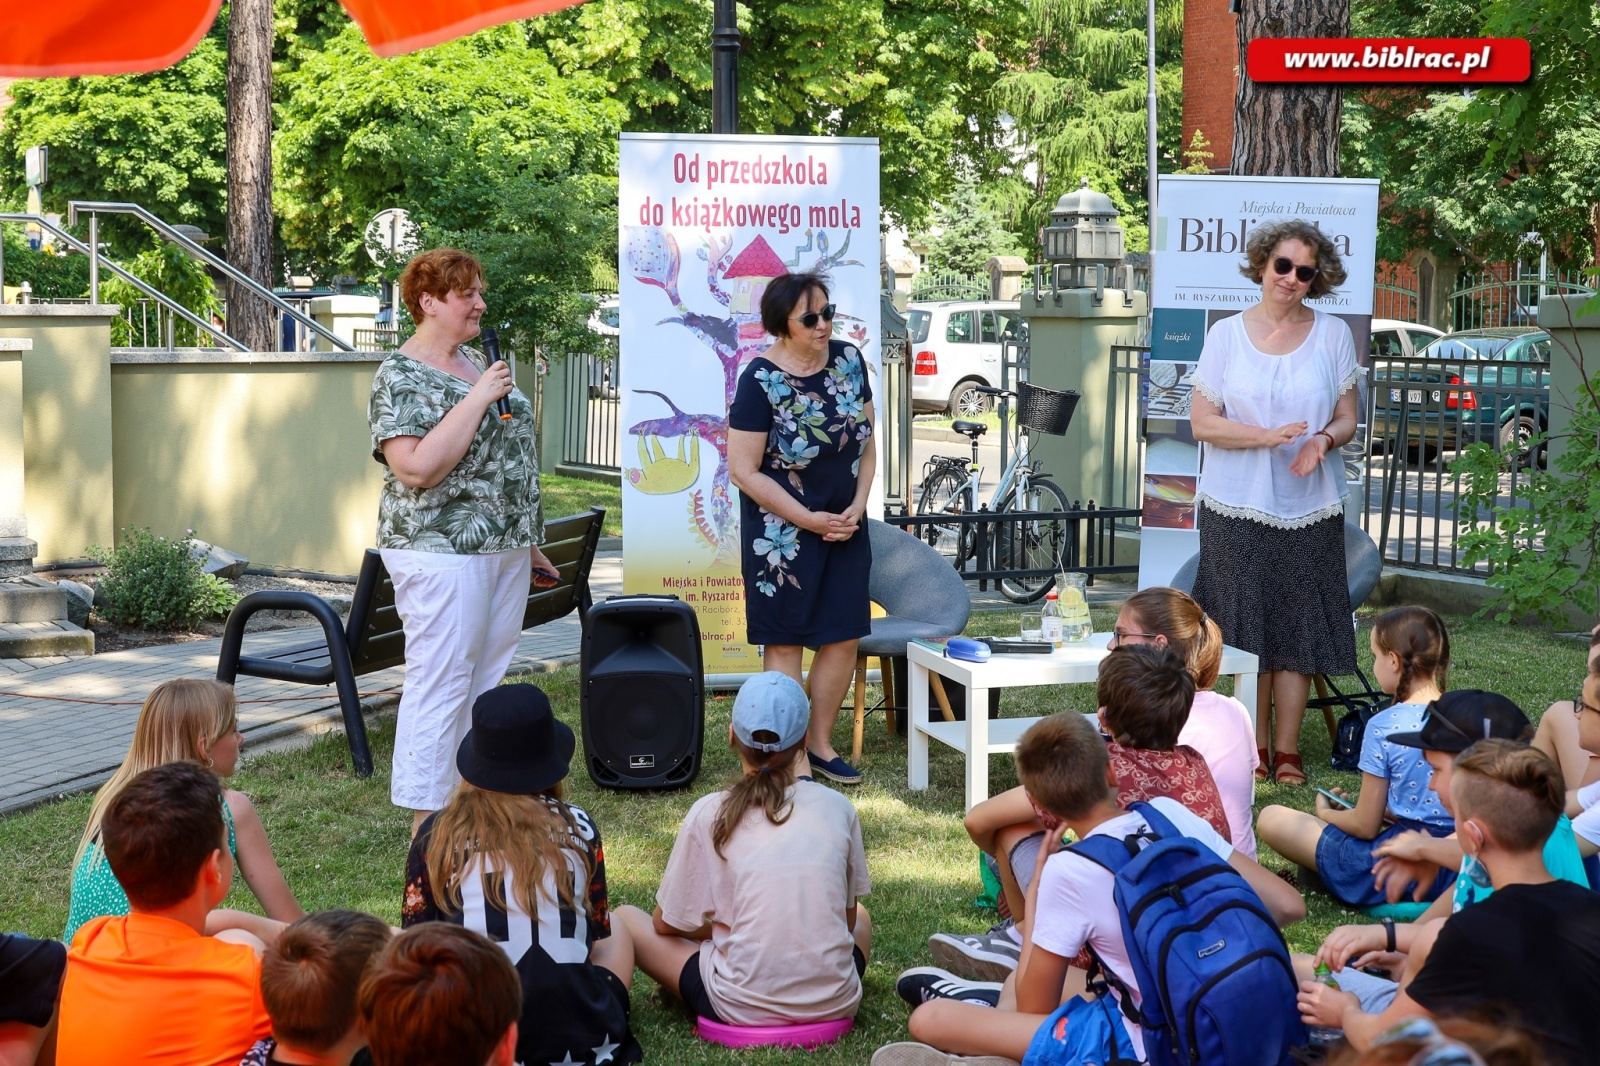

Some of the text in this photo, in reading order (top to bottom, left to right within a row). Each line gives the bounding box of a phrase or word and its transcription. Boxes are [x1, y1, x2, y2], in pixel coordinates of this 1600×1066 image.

[673, 152, 828, 190] Od przedszkola
[1239, 200, 1357, 217] Miejska i Powiatowa
[639, 196, 861, 234] do książkowego mola
[1174, 292, 1189, 301] IM.
[1193, 293, 1241, 303] RYSZARDA
[1244, 295, 1261, 303] KIN
[1164, 331, 1192, 343] książki
[662, 576, 697, 589] Miejska
[685, 591, 699, 602] im.
[702, 590, 740, 604] Ryszarda
[702, 605, 741, 615] Racibórz,
[721, 617, 734, 626] tel.
[700, 631, 735, 643] blrac.pl
